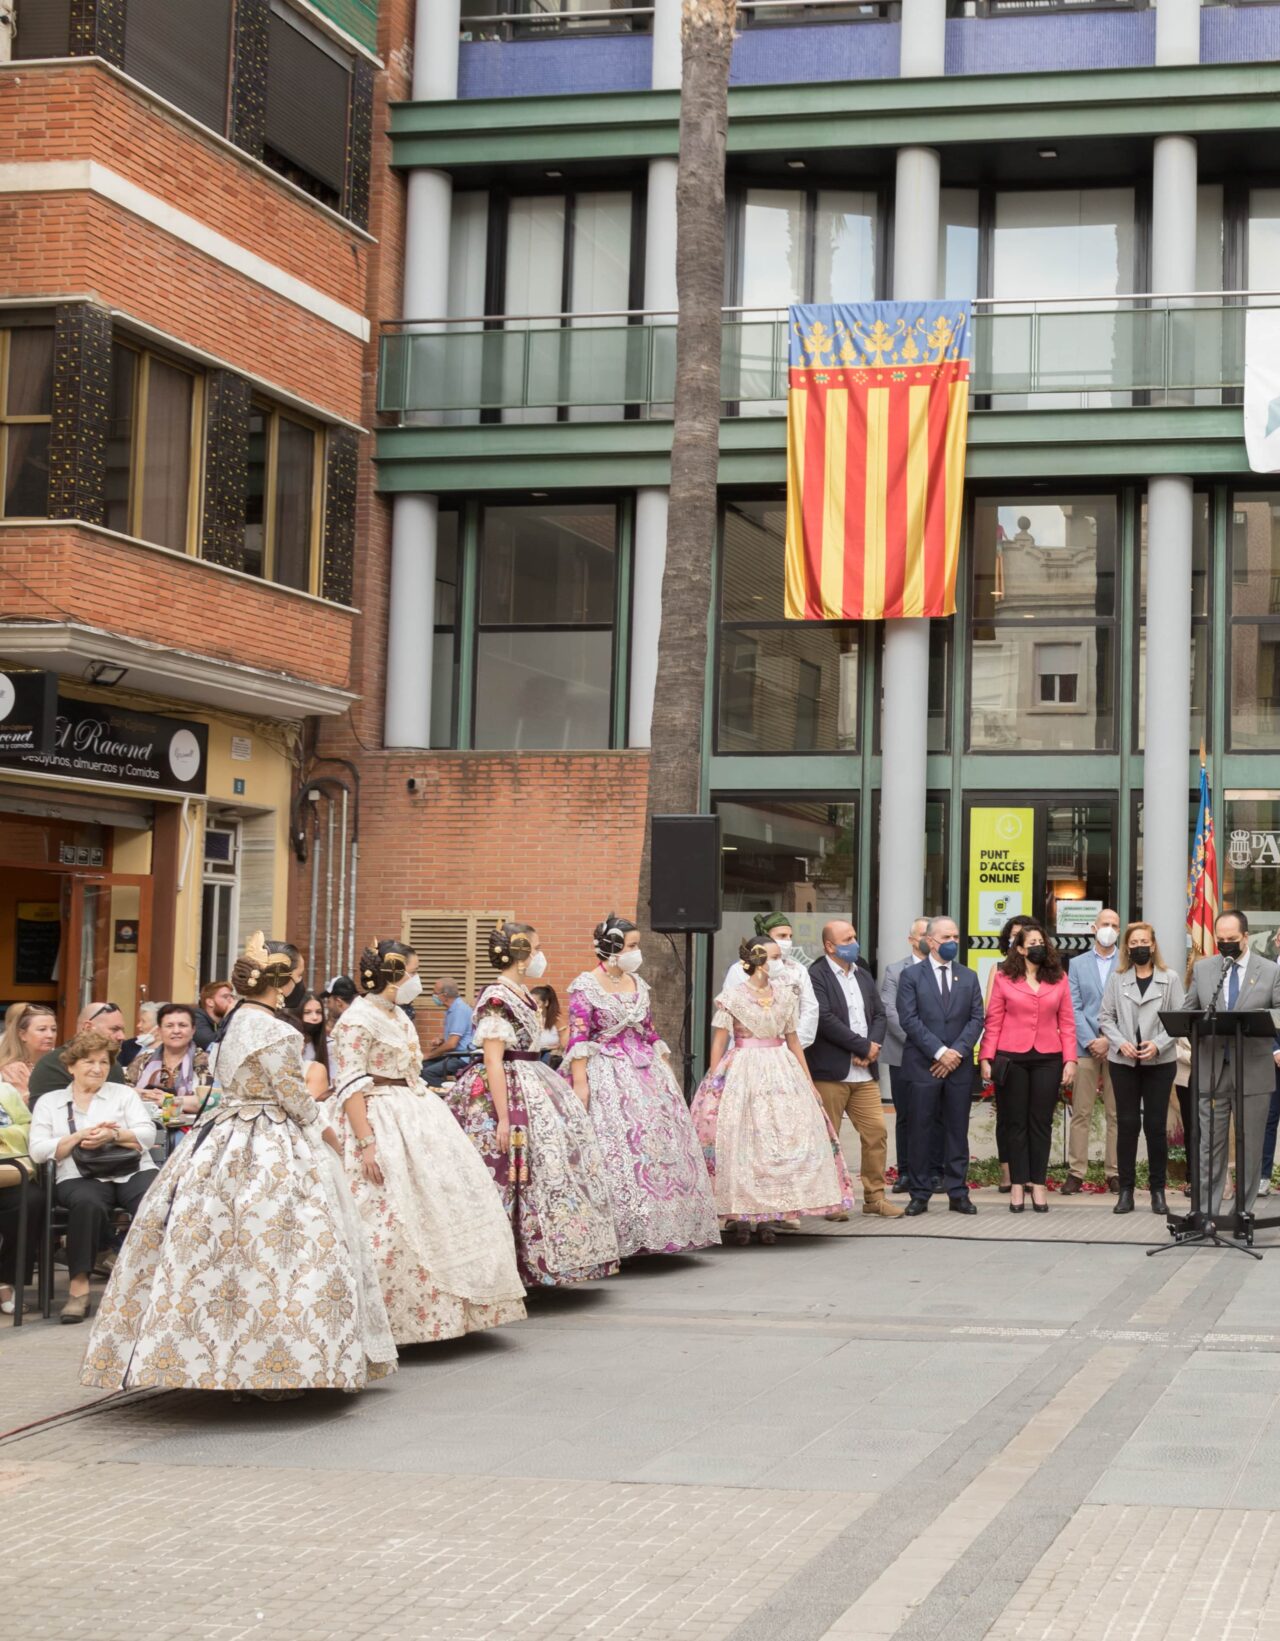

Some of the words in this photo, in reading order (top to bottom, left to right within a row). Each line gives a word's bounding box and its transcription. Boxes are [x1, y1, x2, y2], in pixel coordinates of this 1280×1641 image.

[73, 718, 154, 761] Raconet
[73, 755, 118, 774] almuerzos
[119, 764, 125, 777] y
[126, 763, 161, 780] Comidas
[980, 849, 1010, 860] PUNT
[980, 859, 1025, 872] D'ACCÉS
[979, 873, 1020, 883] ONLINE
